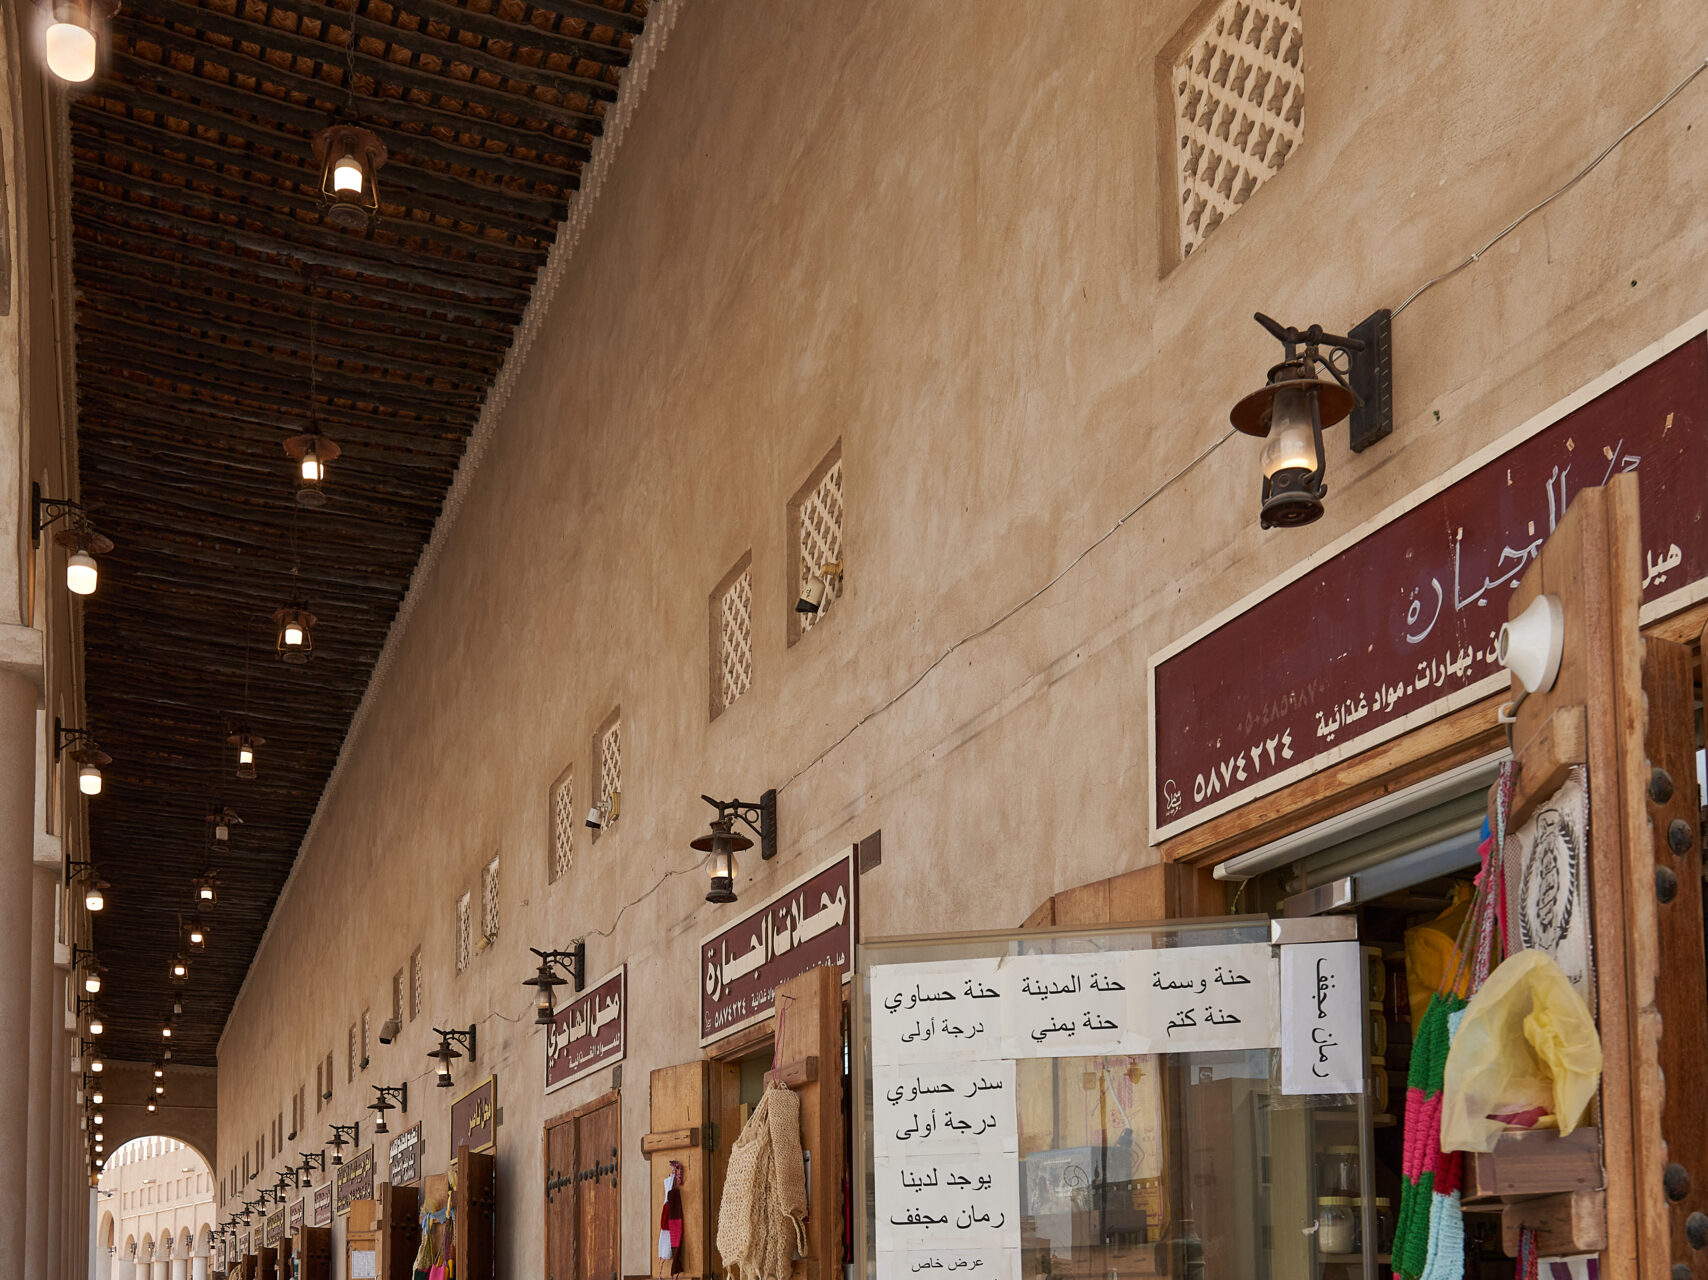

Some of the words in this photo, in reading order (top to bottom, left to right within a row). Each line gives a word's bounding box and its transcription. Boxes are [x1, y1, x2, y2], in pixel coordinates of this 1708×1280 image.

[1414, 644, 1473, 690] بهارات
[1372, 681, 1404, 713] مواد
[1316, 691, 1369, 742] غذائية
[1193, 727, 1294, 803] ٥٨٧٤٢٢٤
[773, 884, 847, 957] محلات
[705, 909, 773, 1002] الجبارة
[963, 978, 1002, 1000] حنة
[1020, 973, 1081, 995] المدينة
[1088, 970, 1127, 993] حنة
[1151, 970, 1208, 995] وسمة
[1213, 967, 1252, 987] حنة
[1311, 956, 1330, 1020] مجفف
[884, 984, 957, 1013] حساوي
[590, 992, 620, 1038] محل
[940, 1017, 985, 1040] درجة
[1081, 1010, 1119, 1031] حنة
[1166, 1007, 1198, 1039] كتم
[1203, 1005, 1243, 1026] حنة
[547, 997, 591, 1069] الهاجري
[900, 1018, 936, 1044] أولى
[1030, 1016, 1077, 1043] يمني
[1311, 1026, 1338, 1079] رمان
[886, 1076, 956, 1107] حساوي
[964, 1076, 1003, 1099] سدر
[894, 1111, 937, 1142] أولى
[943, 1110, 998, 1137] درجة
[900, 1166, 939, 1193] لدينا
[945, 1170, 993, 1193] يوجد
[889, 1206, 949, 1231] مجفف
[955, 1204, 1006, 1231] رمان
[911, 1255, 944, 1274] خاص
[947, 1256, 985, 1272] عرض
